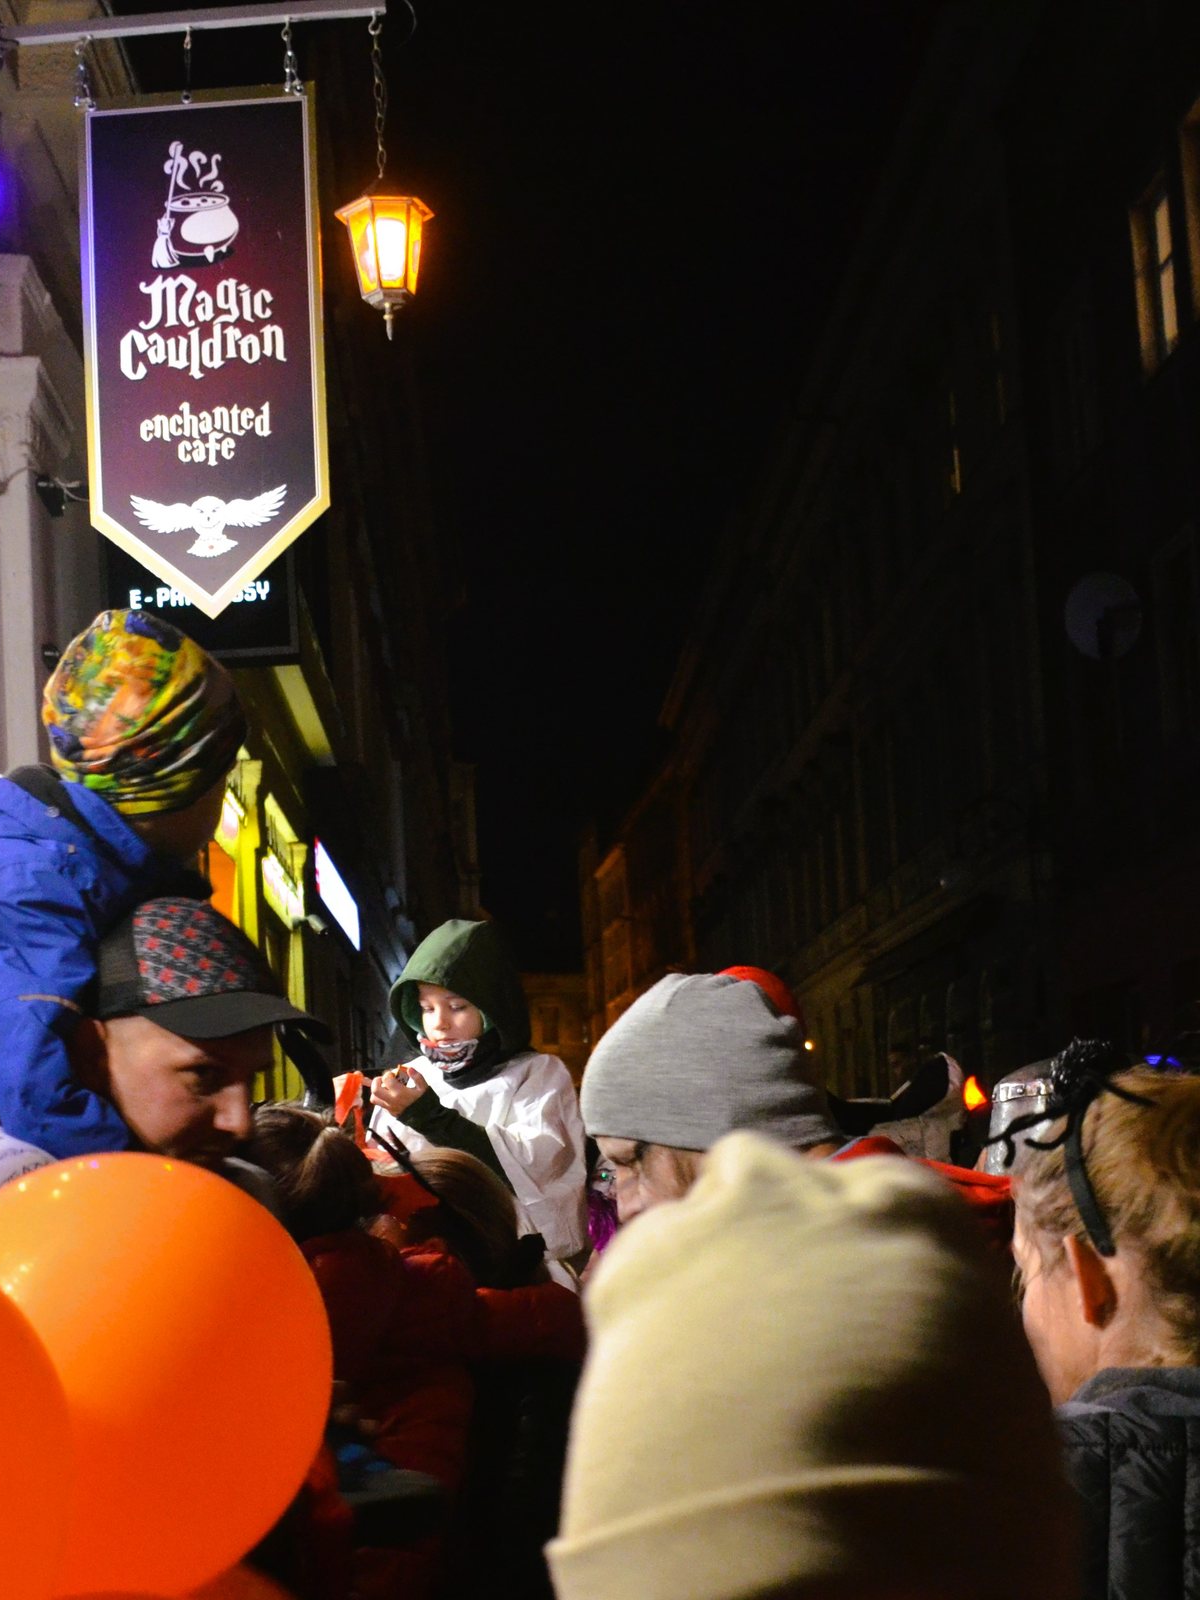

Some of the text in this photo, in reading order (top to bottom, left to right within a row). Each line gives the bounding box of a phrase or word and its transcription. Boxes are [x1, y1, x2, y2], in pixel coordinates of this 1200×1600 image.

[139, 273, 274, 331] Magic
[119, 322, 288, 381] Cauldron
[139, 400, 272, 442] enchanted
[177, 431, 236, 467] cafe
